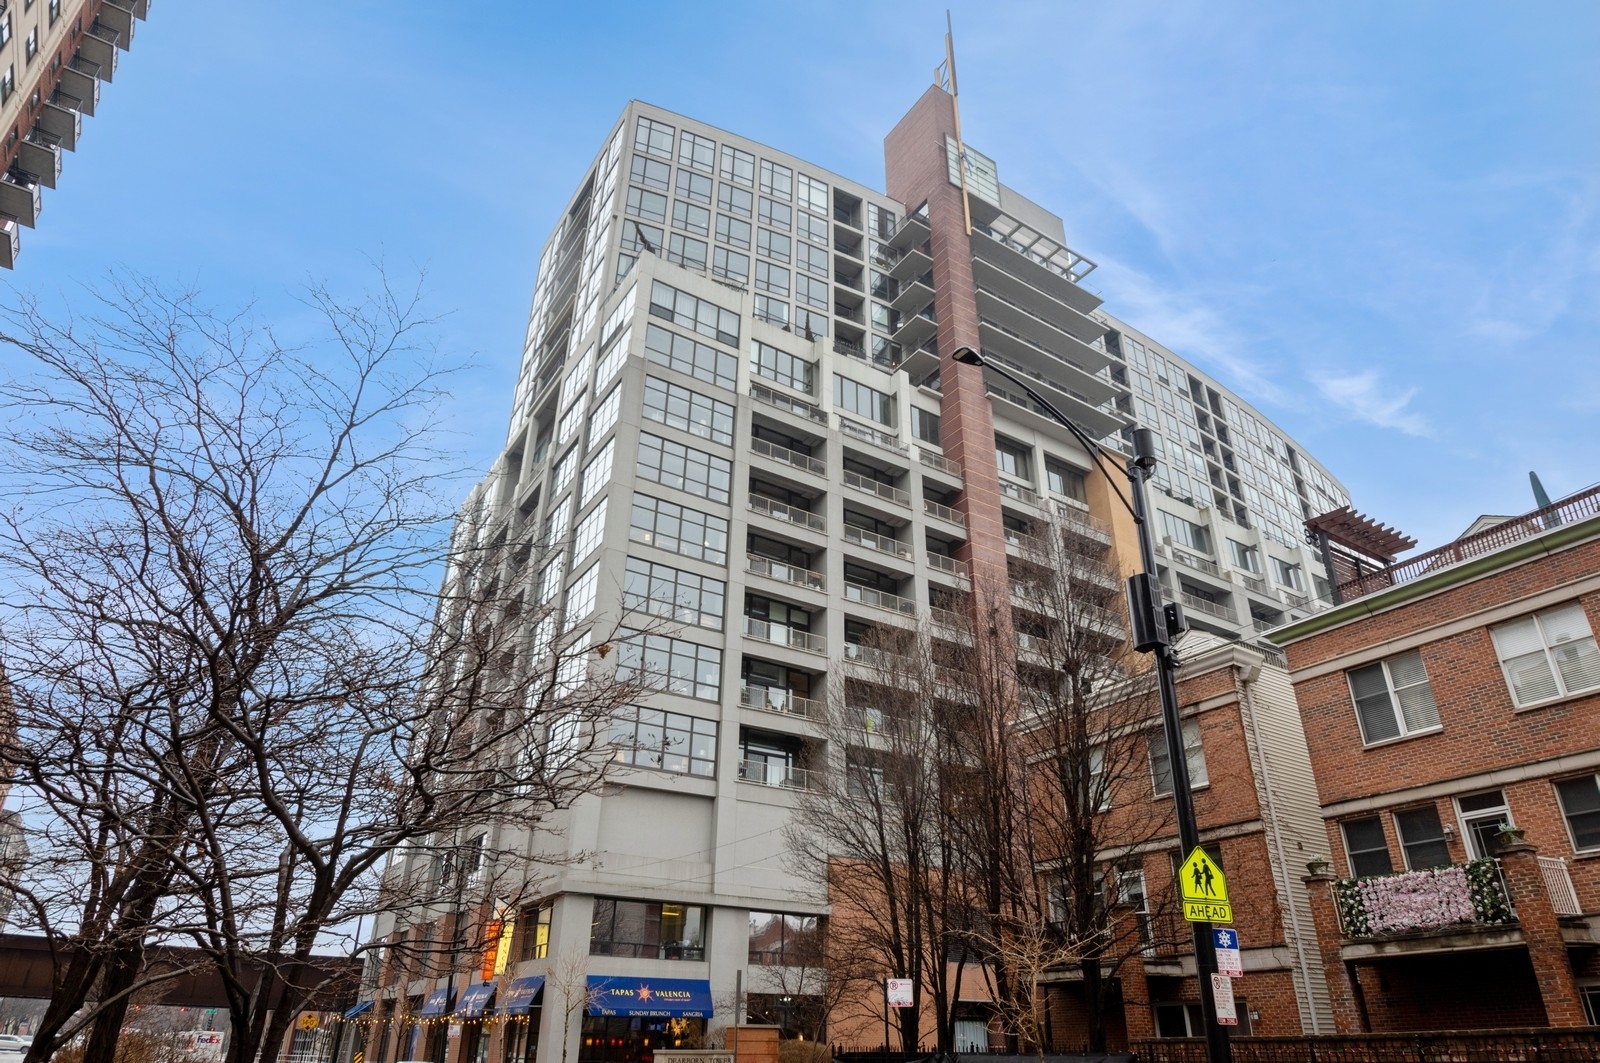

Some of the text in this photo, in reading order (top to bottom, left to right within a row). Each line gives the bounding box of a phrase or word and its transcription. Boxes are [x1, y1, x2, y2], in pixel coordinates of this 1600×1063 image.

[1190, 905, 1227, 918] AHEAD
[611, 988, 691, 998] TAPAS VALENCIA
[197, 1035, 221, 1044] FedEx
